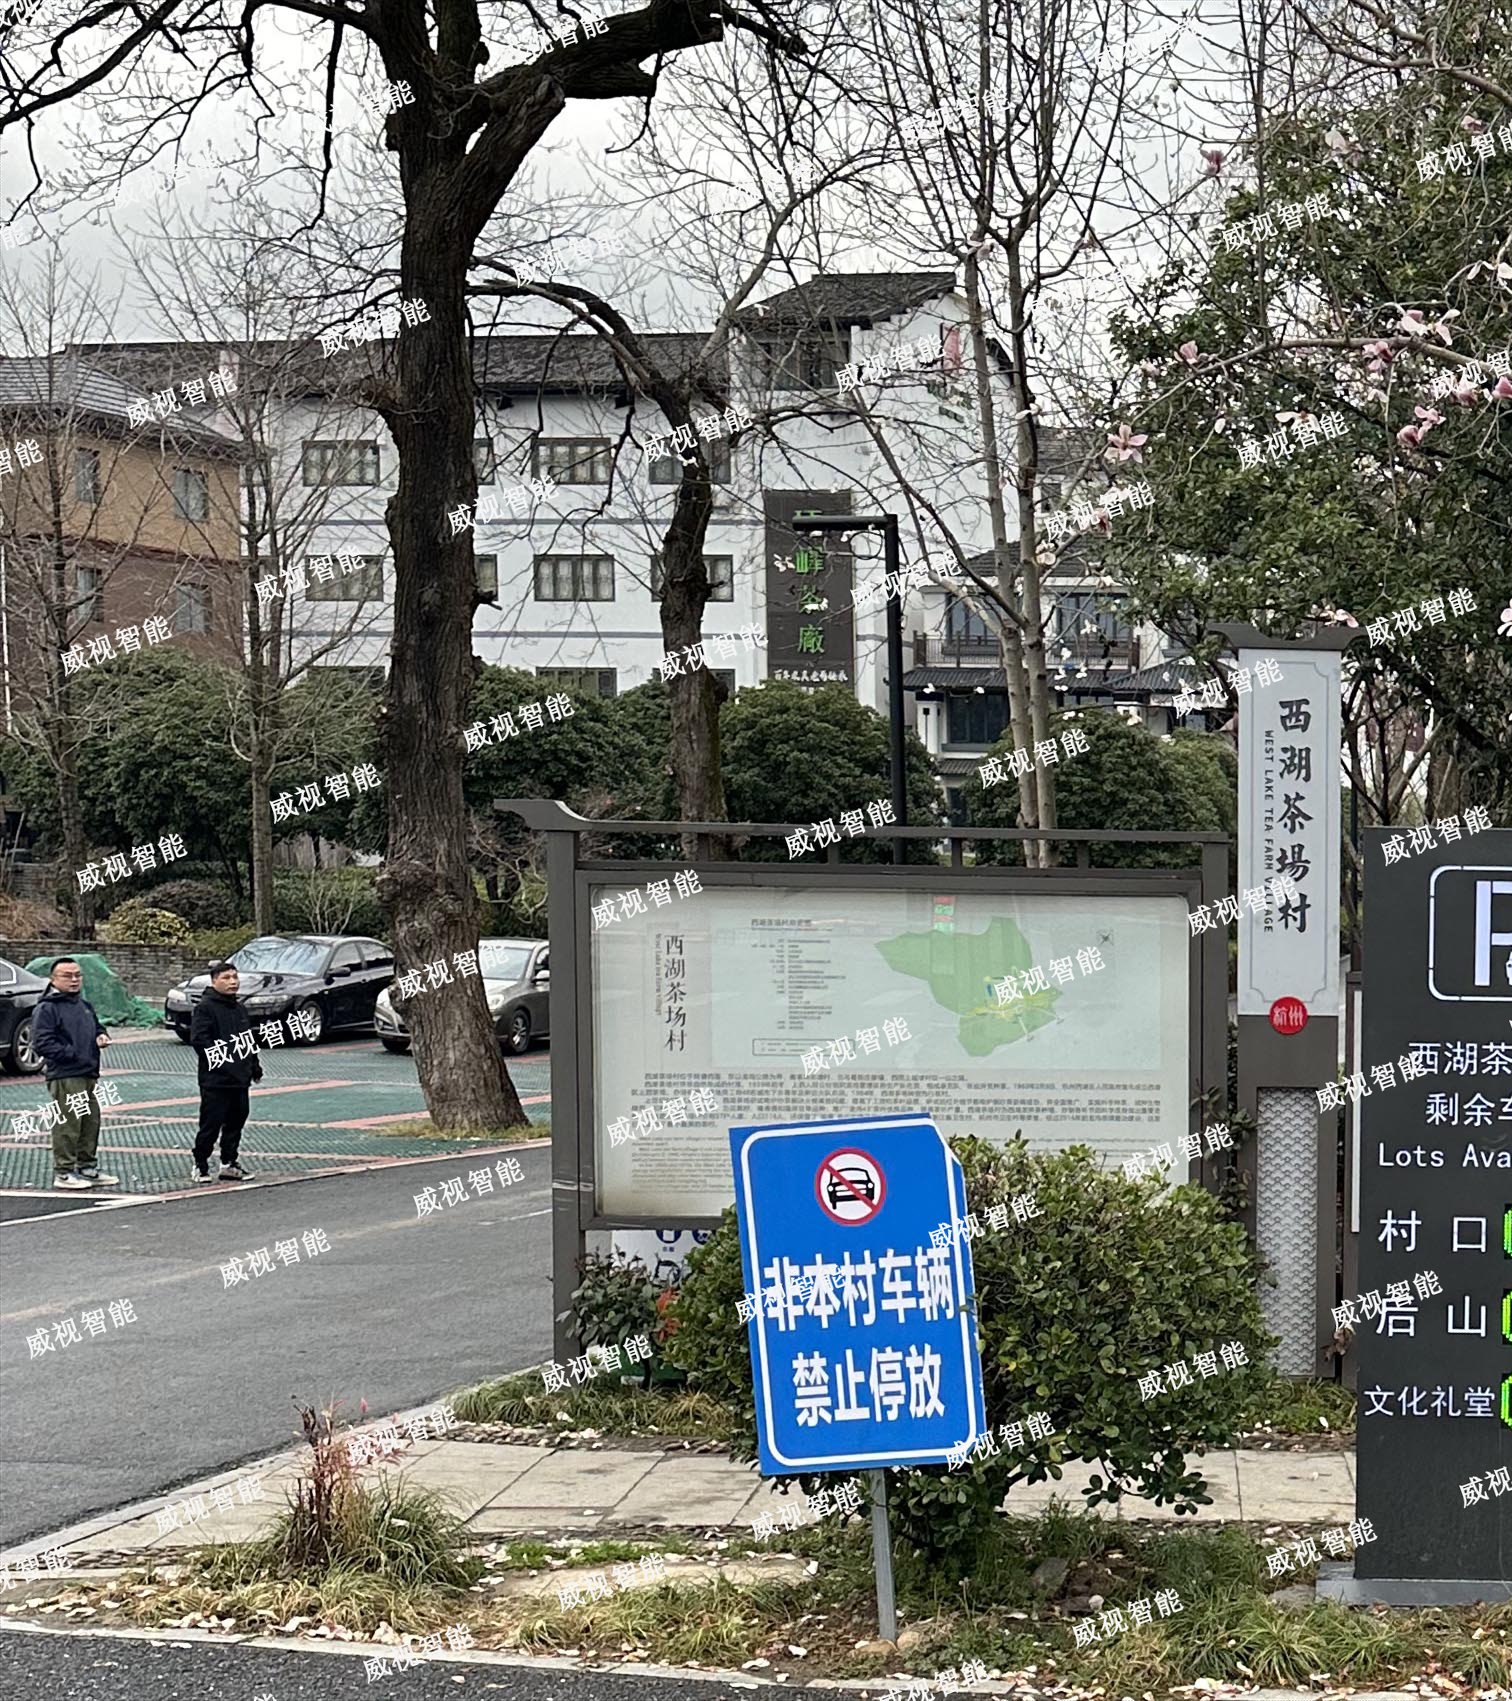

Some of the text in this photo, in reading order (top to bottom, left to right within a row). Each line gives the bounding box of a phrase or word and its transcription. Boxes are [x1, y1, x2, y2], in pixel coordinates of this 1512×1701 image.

[794, 510, 825, 653] 峰茶廠
[1264, 730, 1274, 762] WEST
[1264, 770, 1274, 801] LAKE
[1264, 808, 1274, 831] TEA
[1277, 698, 1314, 933] 西湖茶場村
[1264, 839, 1274, 870] FARM
[664, 934, 687, 1052] 西湖茶场村
[1379, 1143, 1444, 1167] Lots
[764, 1246, 955, 1332] 非本村车辆
[792, 1343, 945, 1428] 禁止停放
[1364, 1385, 1495, 1417] 文化礼堂
